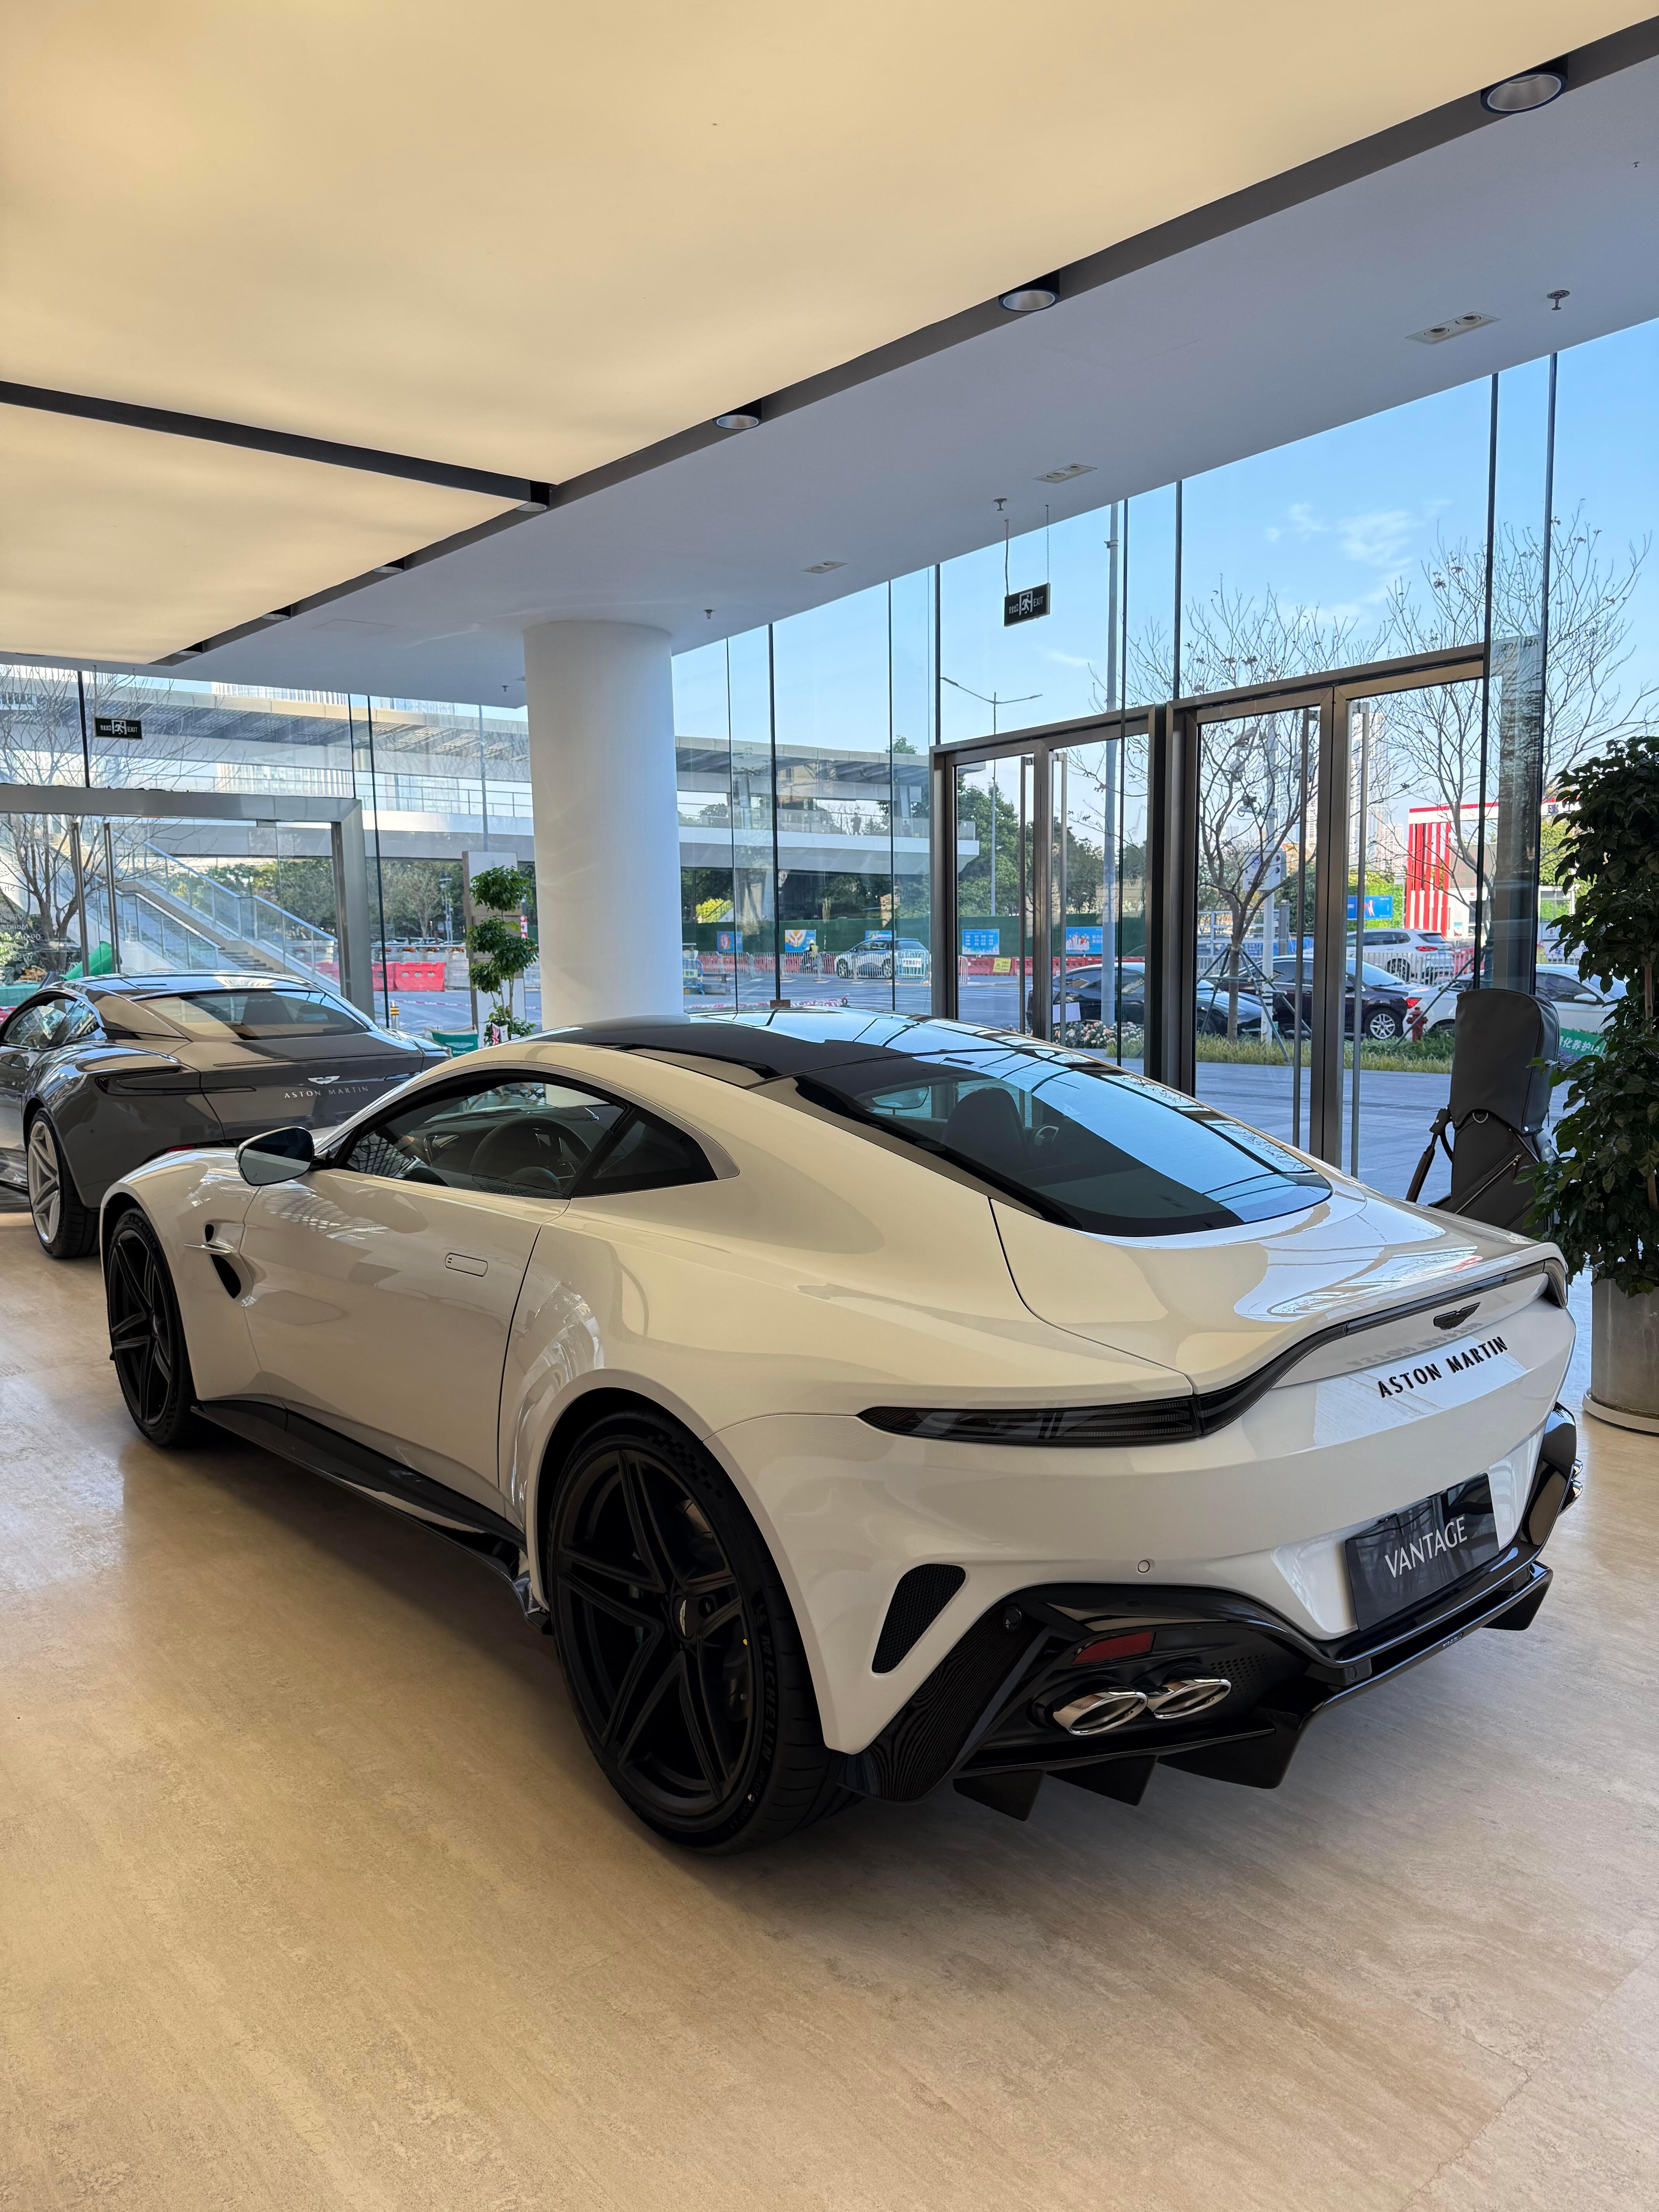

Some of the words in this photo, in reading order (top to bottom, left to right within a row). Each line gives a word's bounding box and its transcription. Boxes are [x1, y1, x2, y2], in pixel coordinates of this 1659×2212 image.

[1033, 596, 1044, 607] EXIT
[285, 1090, 321, 1099] ASTON
[328, 1086, 368, 1095] MARTIN
[1377, 1363, 1442, 1398] ASTON
[1446, 1336, 1508, 1373] MARTIN
[1384, 1516, 1468, 1578] VANTAGE
[760, 1634, 776, 1762] MICHELIN
[753, 1768, 766, 1797] PILOT
